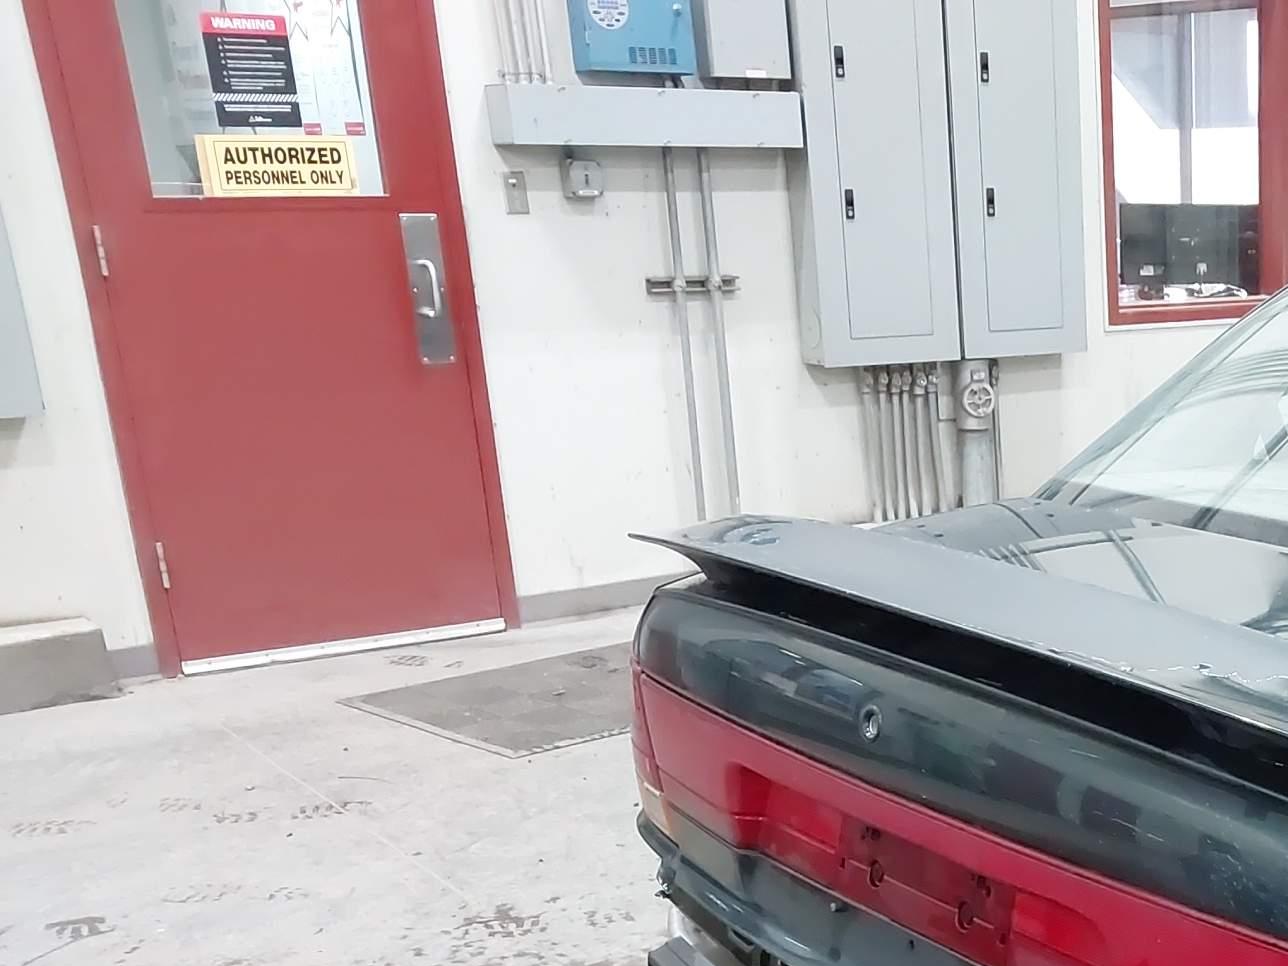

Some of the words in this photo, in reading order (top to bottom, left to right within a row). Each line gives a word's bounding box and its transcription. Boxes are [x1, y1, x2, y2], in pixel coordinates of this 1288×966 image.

[211, 16, 276, 31] WARNING
[223, 147, 342, 165] AUTHORIZED
[225, 170, 306, 185] PERSONNEL
[310, 170, 344, 185] ONLY
